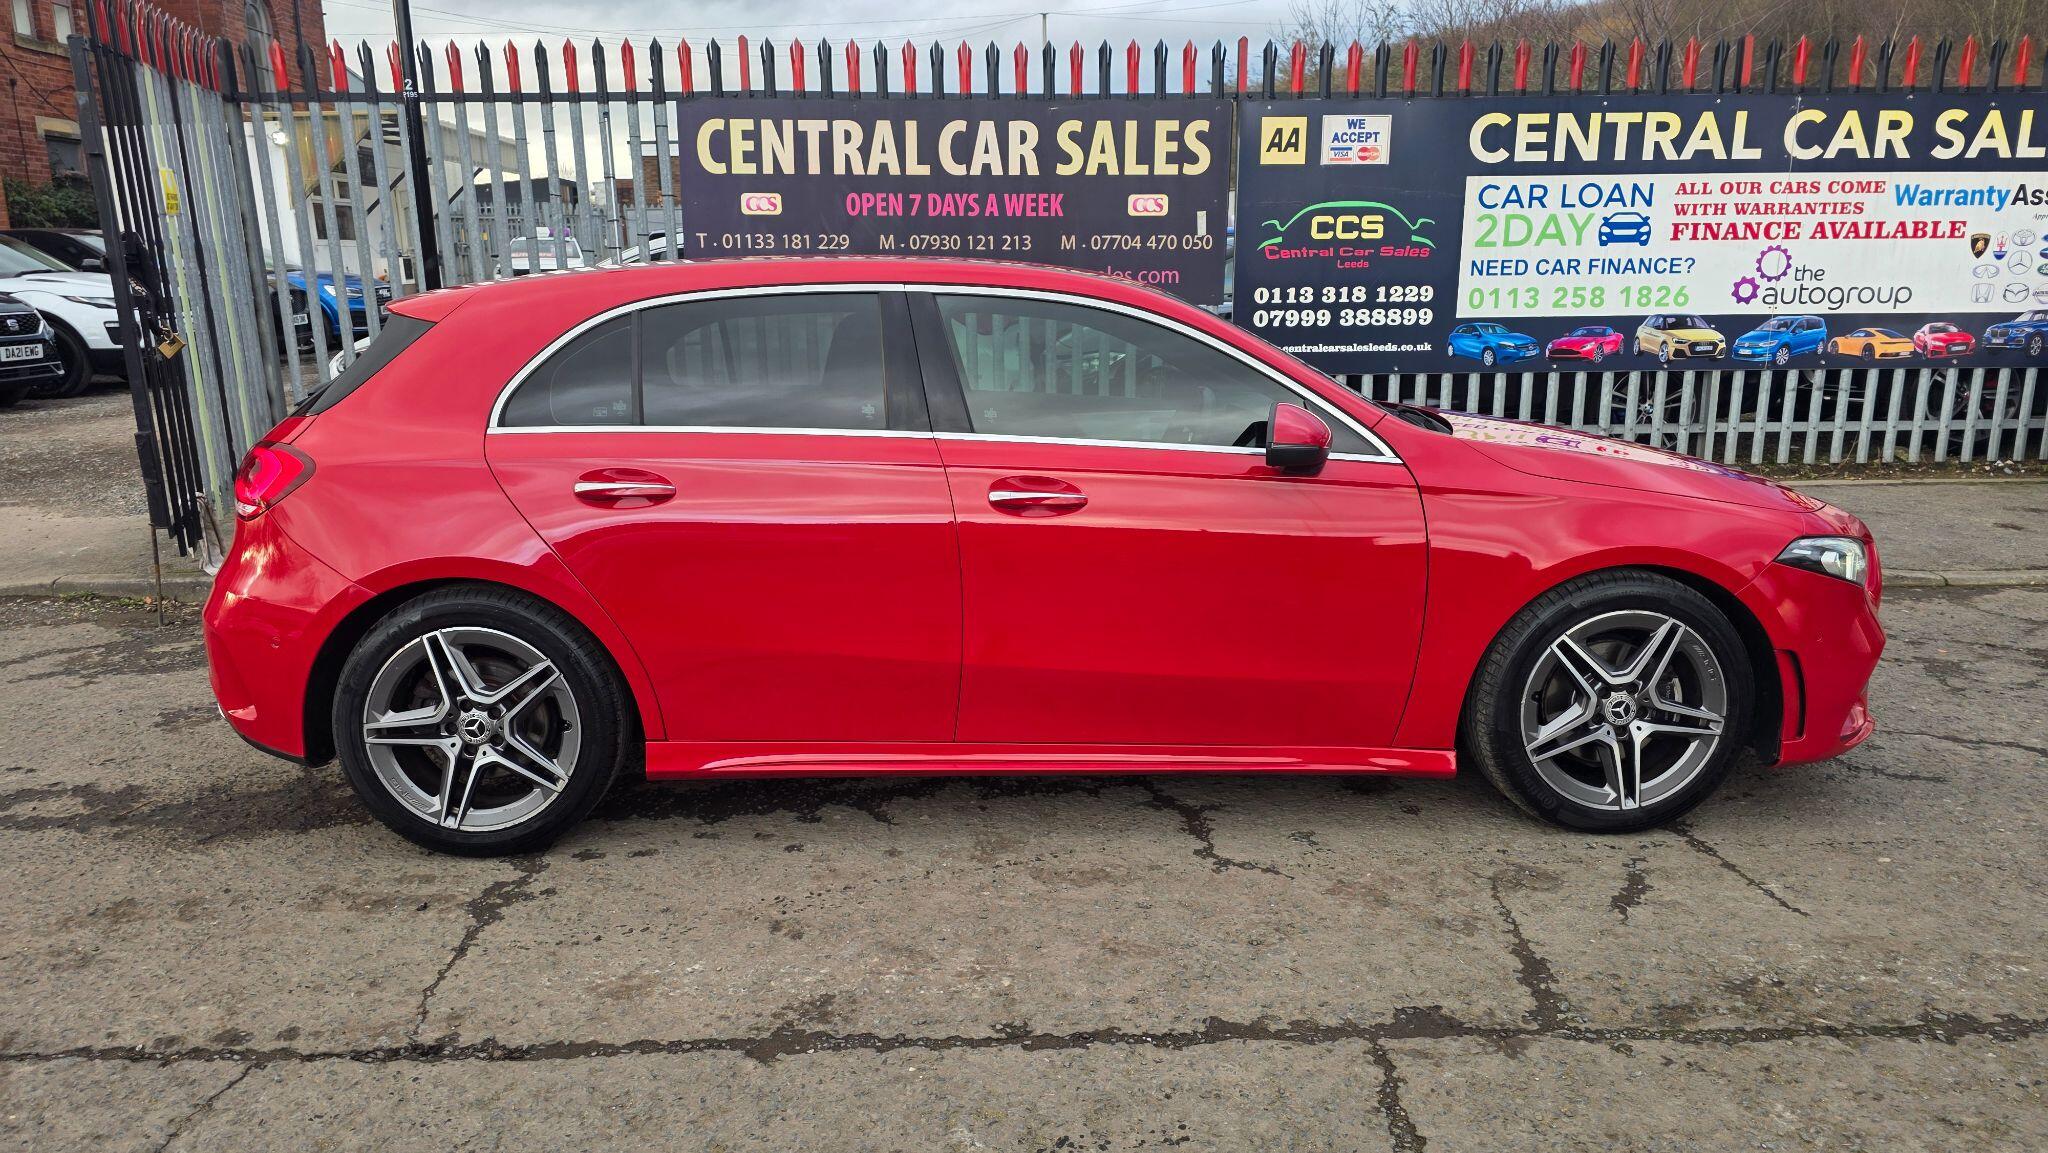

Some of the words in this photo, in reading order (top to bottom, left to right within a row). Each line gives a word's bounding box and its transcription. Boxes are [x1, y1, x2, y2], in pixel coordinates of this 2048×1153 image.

[404, 79, 413, 90] 2
[1347, 118, 1366, 129] WE
[1266, 127, 1299, 152] AA
[1332, 131, 1380, 143] ACCEPT
[1469, 110, 1763, 163] CENTRAL
[1783, 108, 1914, 161] CAR
[1930, 109, 2048, 160] SAL
[696, 119, 931, 175] CENTRAL
[938, 119, 1039, 176] CAR
[1056, 119, 1211, 176] SALES
[1478, 183, 1548, 209] CAR
[1560, 182, 1654, 209] LOAN
[1675, 182, 1713, 195] ALL
[1719, 181, 1763, 195] OUR
[1769, 181, 1821, 194] CARS
[1827, 180, 1887, 194] COME
[746, 196, 778, 212] CCS
[846, 192, 903, 217] OPEN
[909, 193, 922, 217] 7
[928, 193, 980, 217] DAYS
[985, 193, 999, 217] A
[1004, 193, 1064, 217] WEEK
[1132, 197, 1164, 213] CCS
[1674, 203, 1726, 216] WITH
[1734, 201, 1865, 216] WARRANTIES
[1310, 214, 1384, 240] CCS
[1474, 213, 1596, 248] 2DAY
[1670, 221, 1802, 241] FINANCE
[1809, 220, 1967, 239] AVAILABLE
[722, 233, 775, 249] 01133
[783, 234, 811, 249] 181
[818, 234, 850, 249] 229
[909, 234, 960, 250] 07930
[967, 235, 994, 250] 121
[1001, 235, 1032, 250] 213
[1091, 234, 1141, 250] 07704
[1146, 234, 1177, 250] 470
[1182, 234, 1213, 250] 050
[1264, 245, 1334, 260] Central
[1339, 247, 1374, 257] Car
[1379, 246, 1431, 258] Sales
[1337, 260, 1369, 268] Leeds
[1470, 259, 1528, 276] NEED
[1535, 259, 1581, 275] CAR
[1588, 257, 1696, 275] FINANCE?
[1794, 264, 1825, 282] the
[1254, 286, 1314, 304] 0113
[1321, 285, 1367, 304] 318
[1376, 285, 1434, 303] 1229
[1468, 287, 1540, 310] 0113
[1551, 286, 1605, 309] 258
[1619, 285, 1690, 308] 1826
[1762, 283, 1913, 310] autogroup
[1253, 309, 1332, 328] 07999
[1339, 308, 1433, 327] 388899
